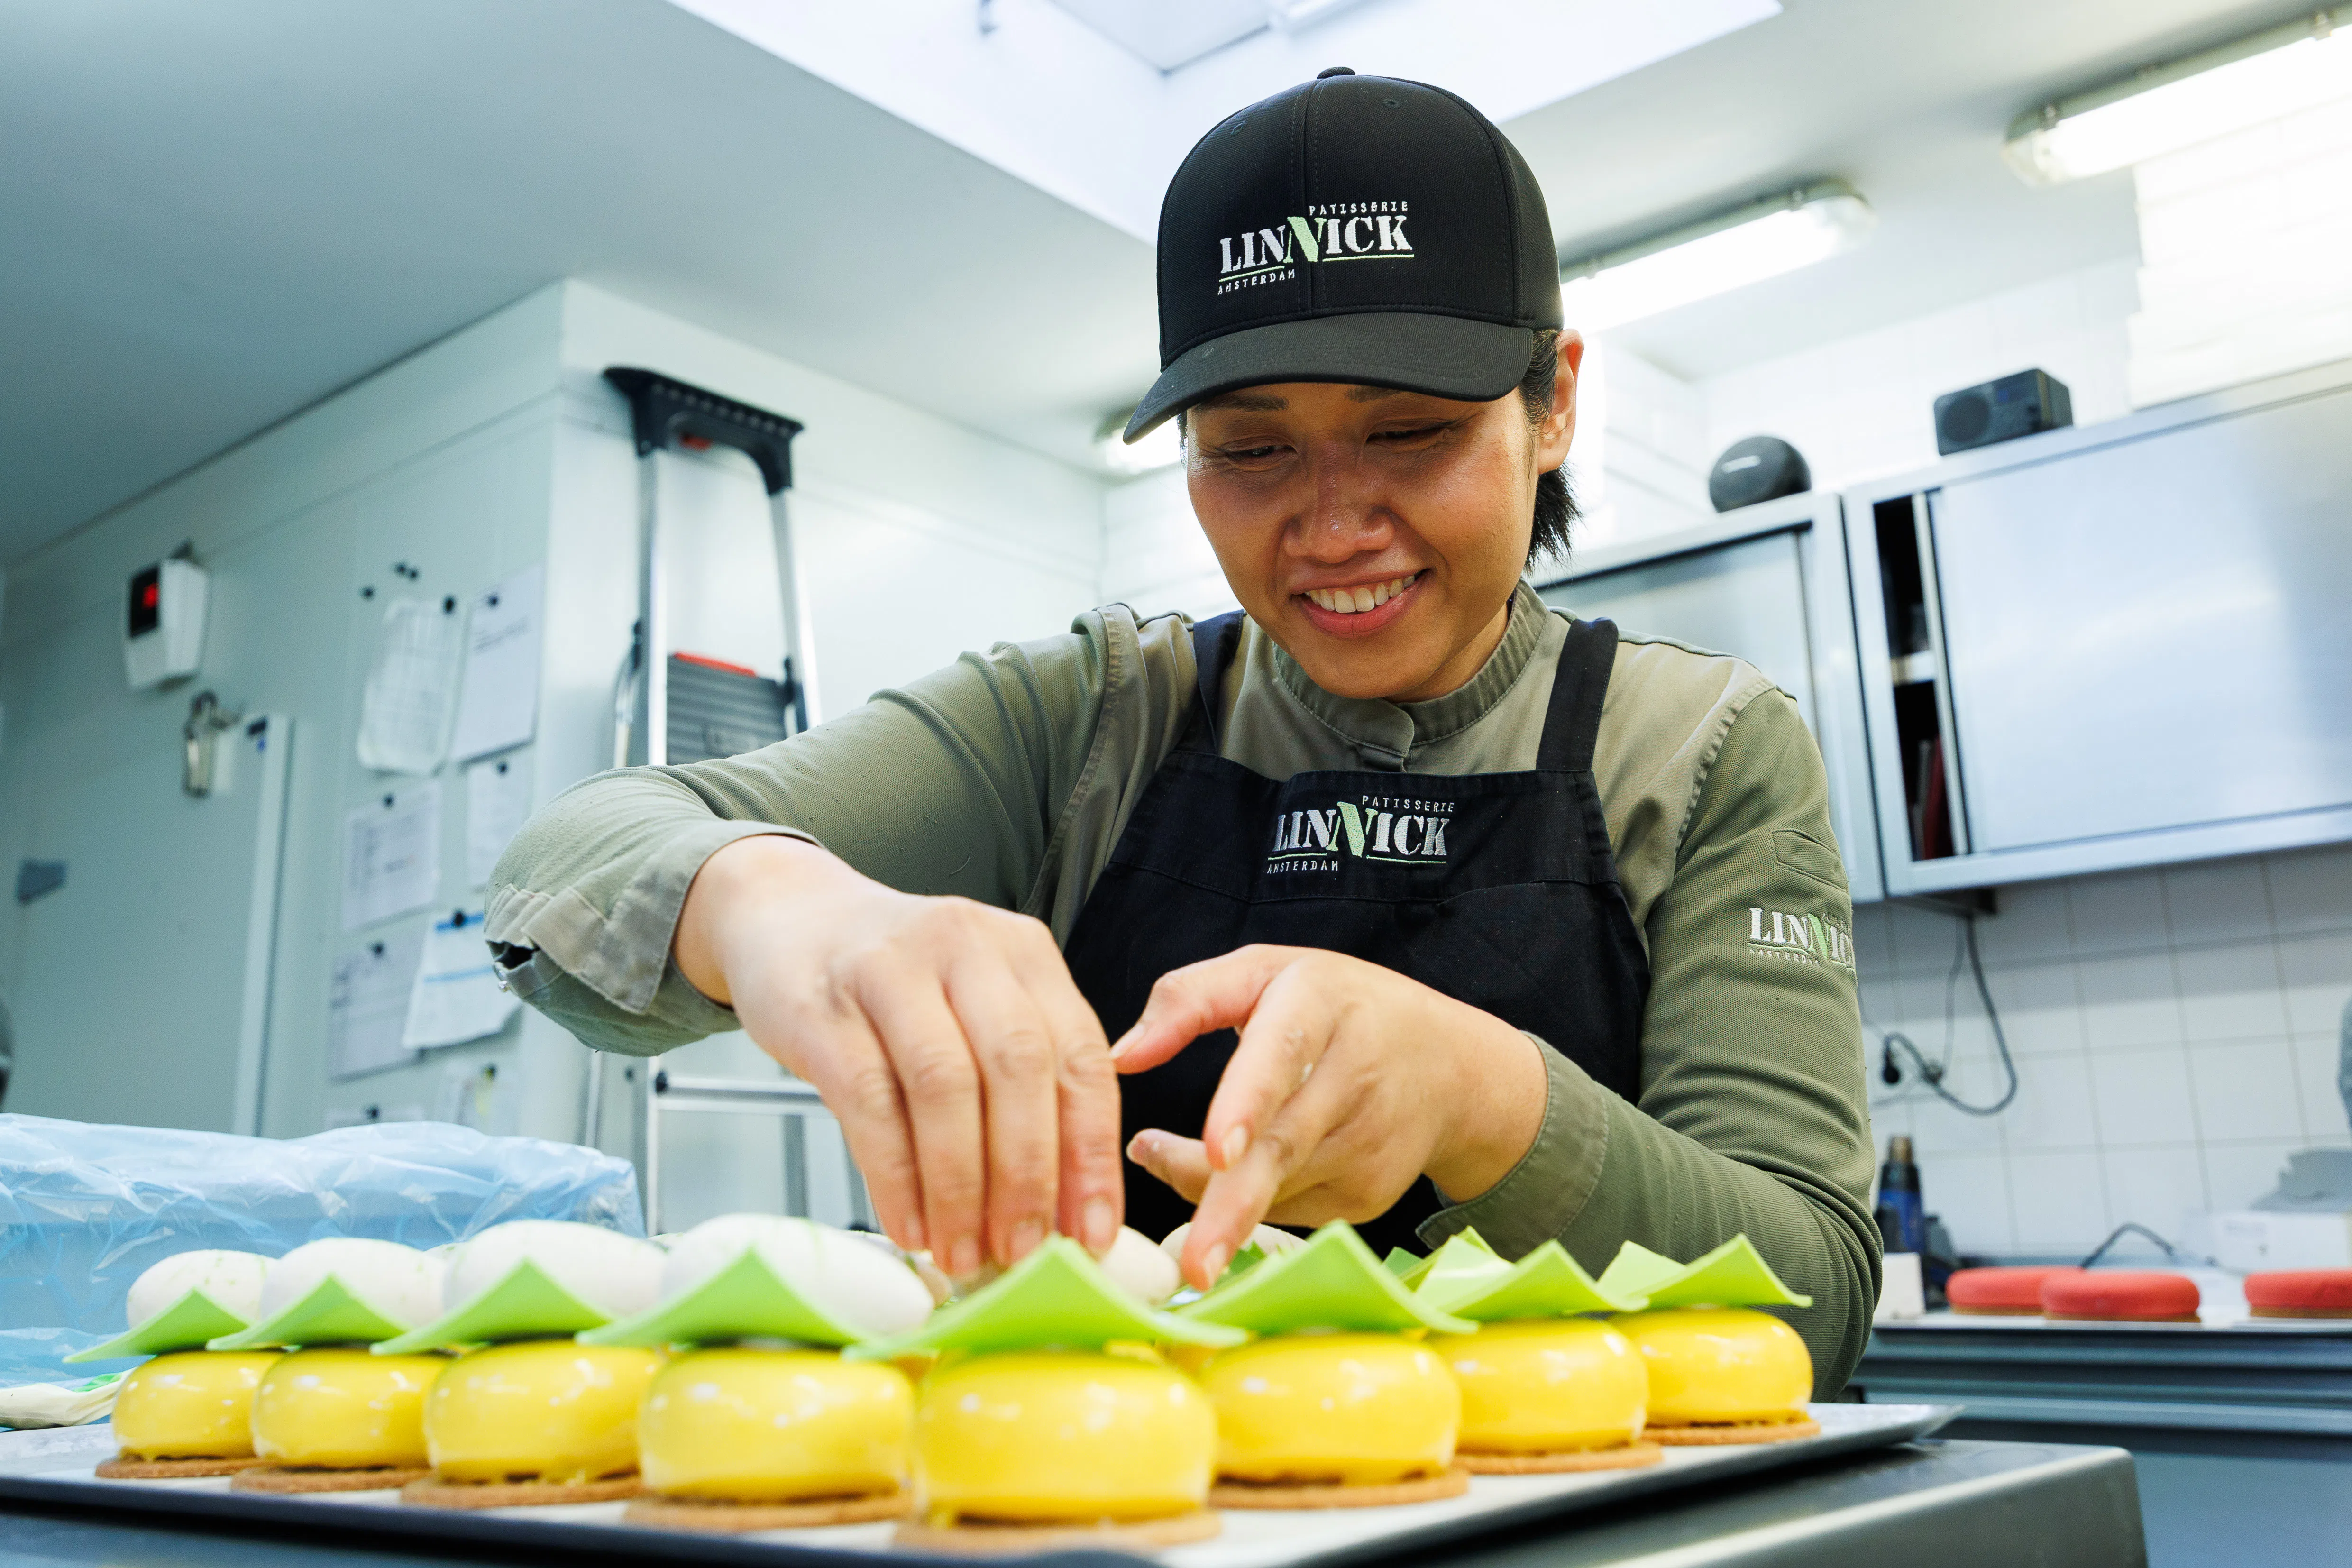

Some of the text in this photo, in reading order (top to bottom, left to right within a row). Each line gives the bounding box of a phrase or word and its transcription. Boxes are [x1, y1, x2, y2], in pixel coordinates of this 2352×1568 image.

[1309, 201, 1408, 216] PATISSERIE
[1220, 216, 1413, 274] LINNICK
[1218, 269, 1295, 295] AMSTERDAM
[1362, 795, 1455, 812] PATISSERIE
[1272, 802, 1450, 858] LINNICK
[1267, 860, 1338, 874] AMSTERDAM
[1749, 907, 1855, 968] LINNIC
